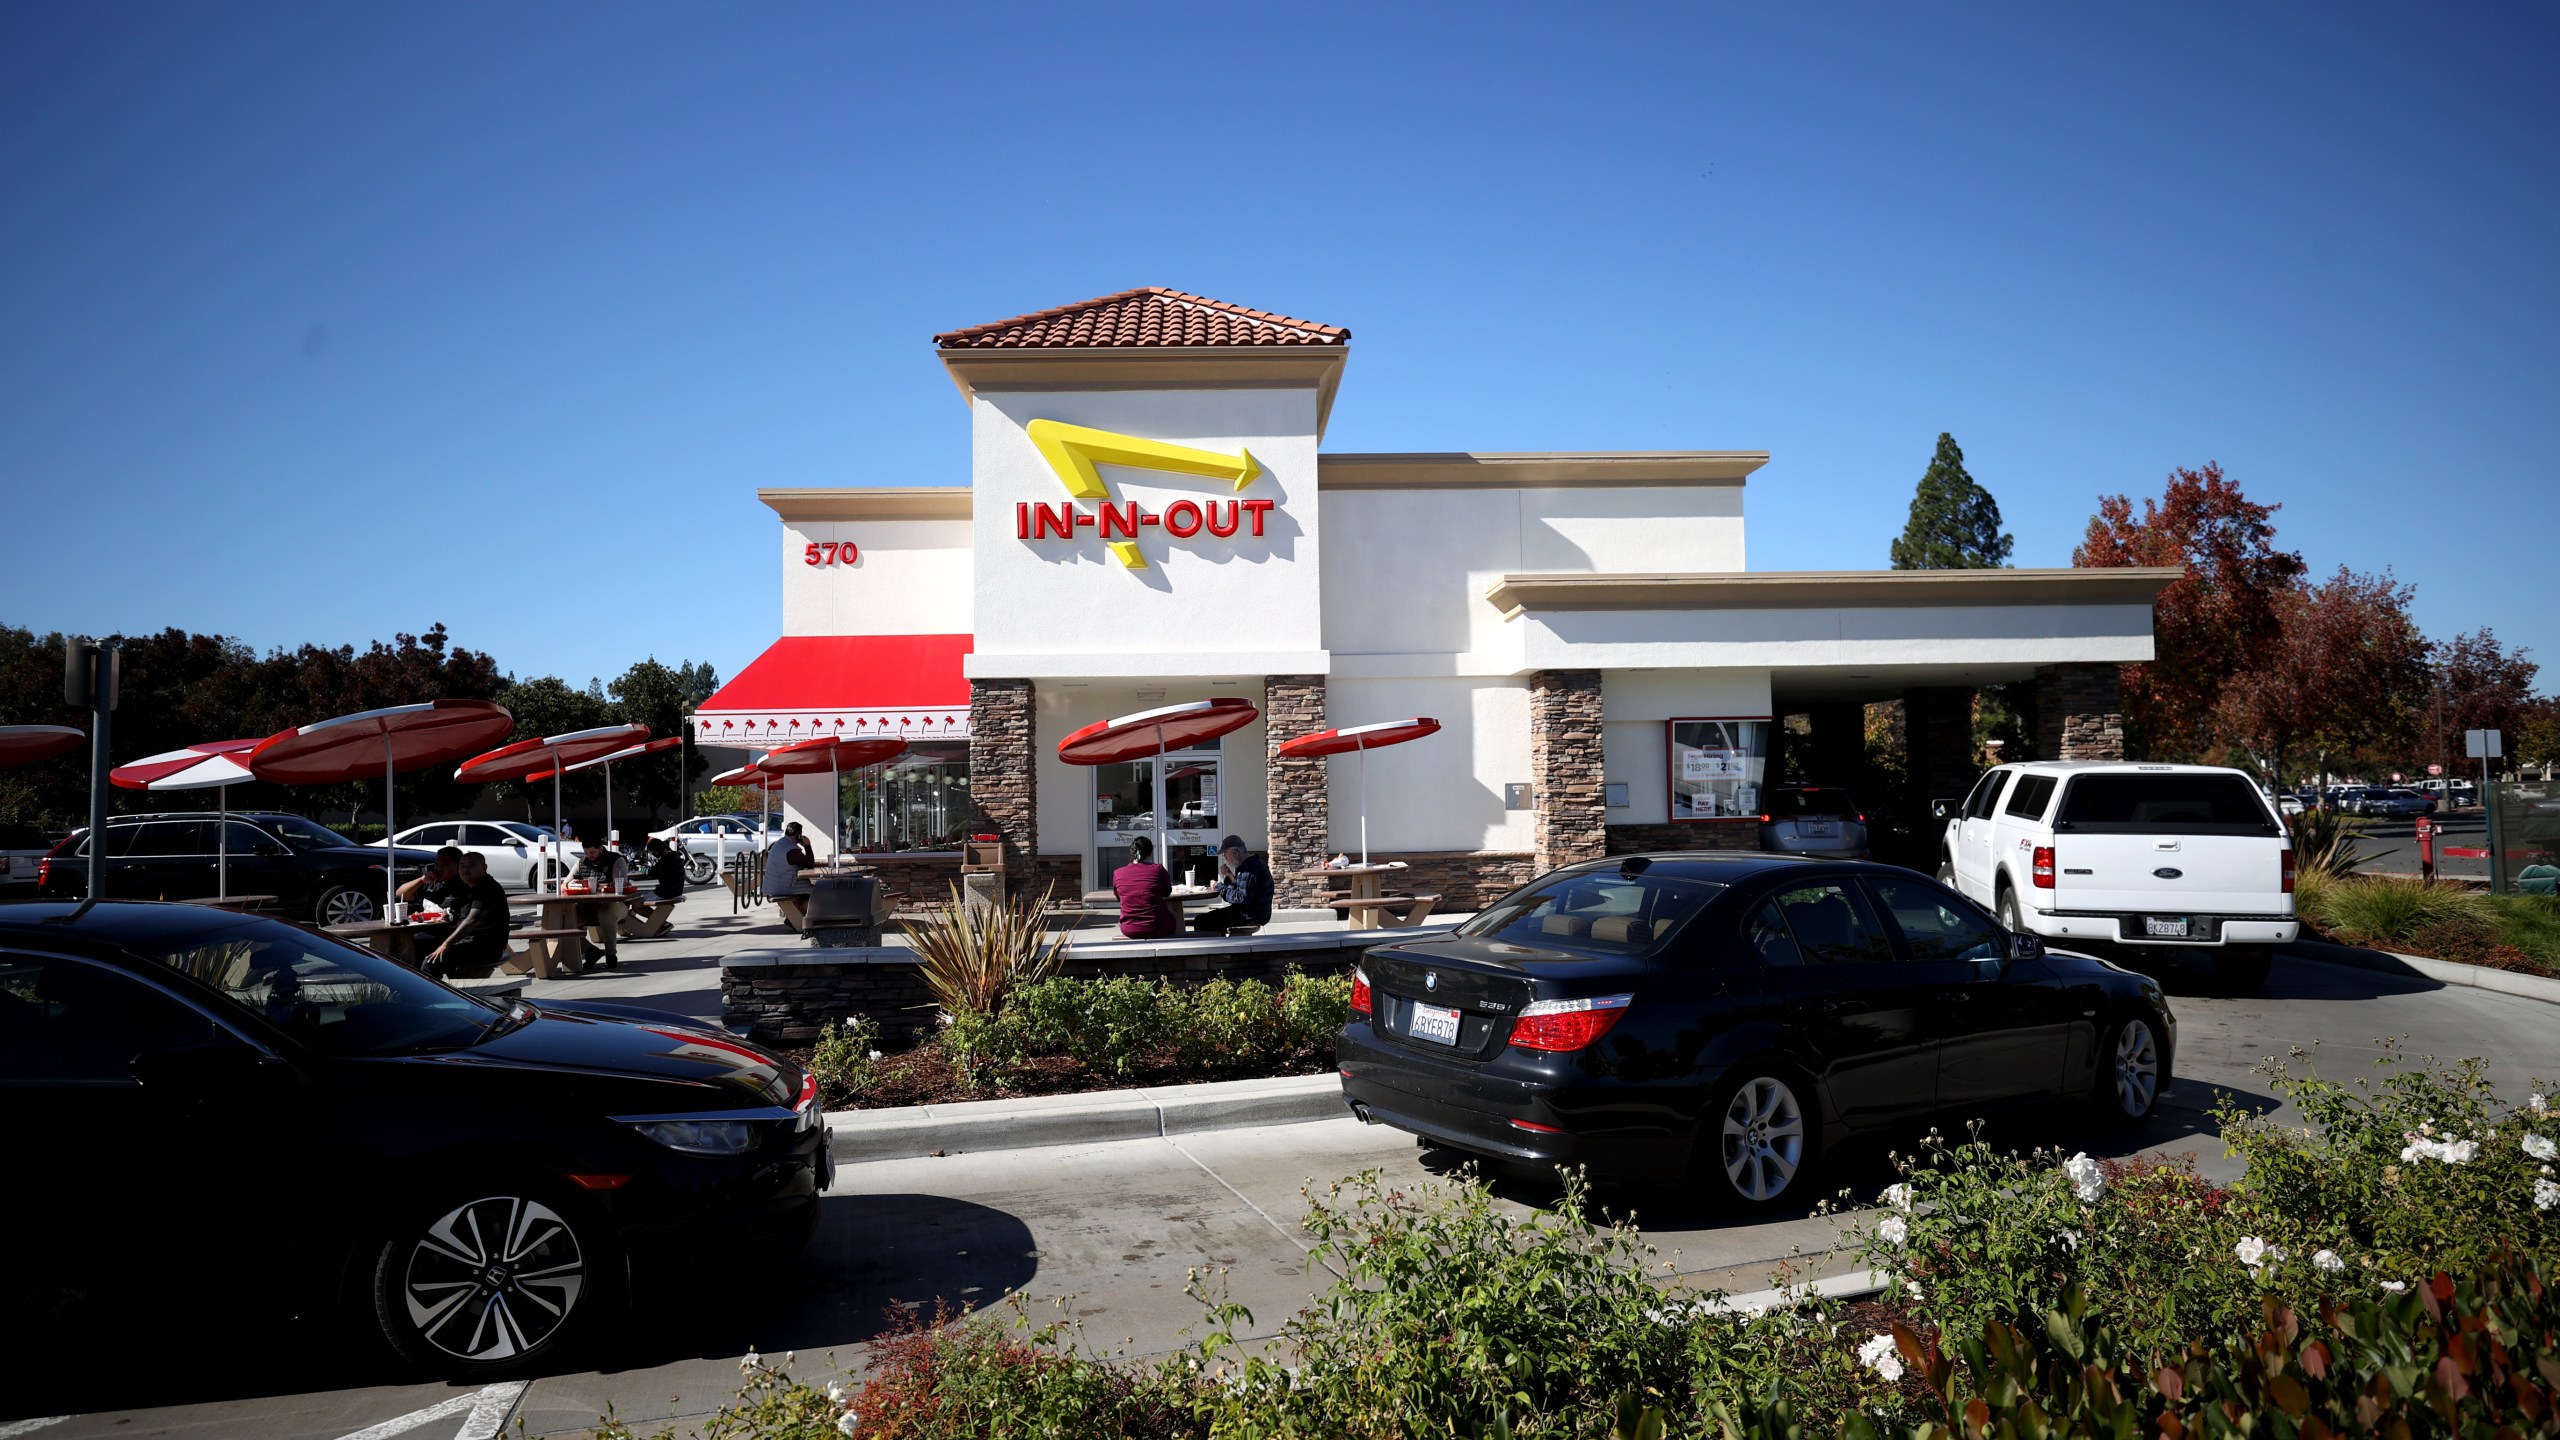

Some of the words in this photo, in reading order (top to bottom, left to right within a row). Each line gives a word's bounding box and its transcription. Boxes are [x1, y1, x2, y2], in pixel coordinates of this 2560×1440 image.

[1017, 500, 1274, 539] IN-N-OUT
[804, 542, 858, 565] 570
[2147, 922, 2186, 934] 8K28748
[1414, 1015, 1455, 1039] 6BYE878
